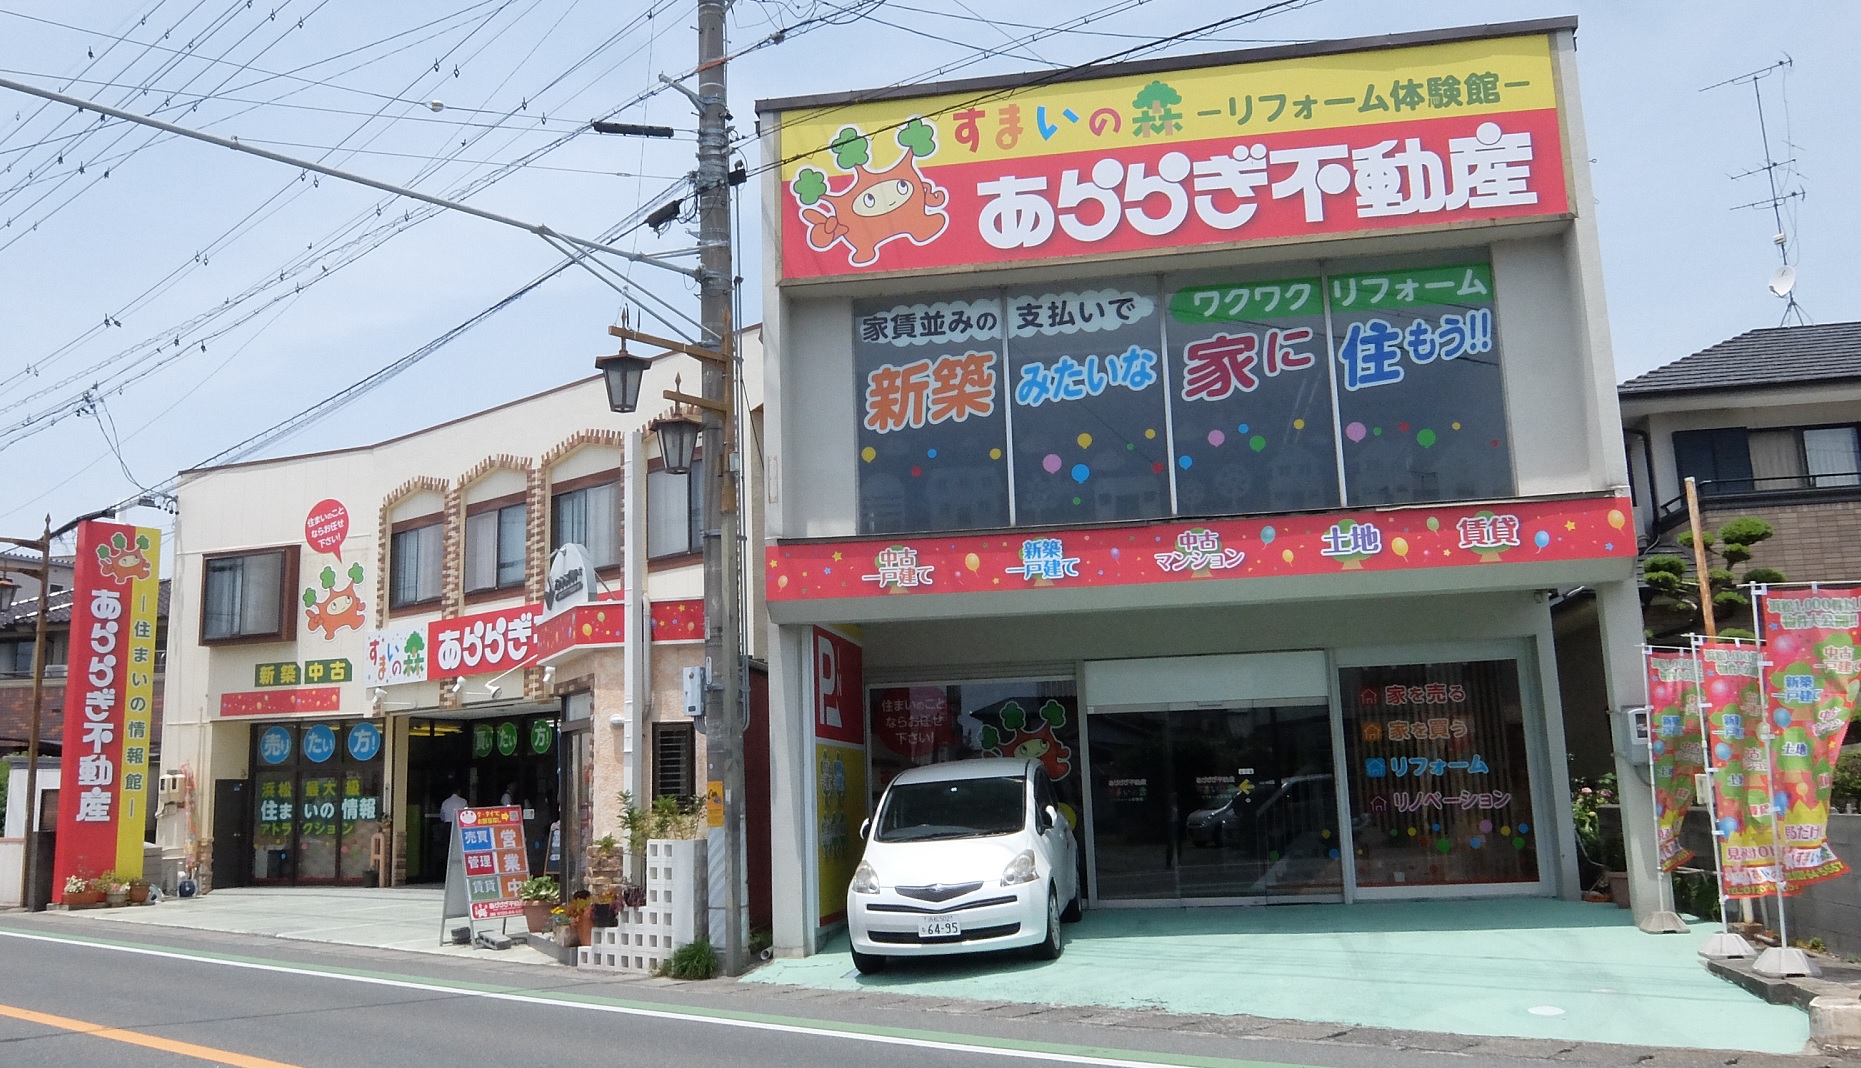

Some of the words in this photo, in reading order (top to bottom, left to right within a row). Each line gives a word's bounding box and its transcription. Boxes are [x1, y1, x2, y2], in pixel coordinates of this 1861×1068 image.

[952, 80, 1184, 153] すまいの森
[976, 121, 1540, 250] あららぎ不動産
[861, 312, 998, 344] 家賃並みの
[1016, 296, 1136, 330] 支払いで
[1193, 282, 1312, 317] ワクワク
[1333, 270, 1488, 306] リフォーム
[866, 351, 997, 432] 新築
[1016, 345, 1158, 407] みたいな
[1183, 327, 1316, 402] 家に
[307, 507, 345, 528] 住まいのこと
[311, 519, 345, 539] ならお任せ
[1177, 531, 1219, 552] 中古
[1320, 524, 1382, 556] 土地
[1457, 514, 1521, 549] 賃貸
[877, 546, 917, 568] 中古
[1022, 538, 1062, 560] 新築
[1155, 547, 1245, 572] マンション
[861, 565, 934, 589] 一戸建て
[1005, 557, 1080, 581] 一戸建て
[437, 611, 538, 670] あららぎ
[259, 662, 297, 683] 新築
[308, 661, 346, 682] 中古
[1784, 675, 1814, 689] 新築
[76, 588, 122, 822] あららぎ不動産
[1385, 682, 1466, 705] 家を売る
[1387, 718, 1469, 741] 家を買う
[264, 733, 291, 757] 売り
[307, 731, 333, 754] たい
[1390, 753, 1489, 779] リフォーム
[1393, 790, 1512, 814] リノベーション
[464, 830, 489, 844] 売買
[467, 854, 493, 869] 管理
[472, 879, 497, 894] 賃貸
[927, 922, 958, 935] 64-95
